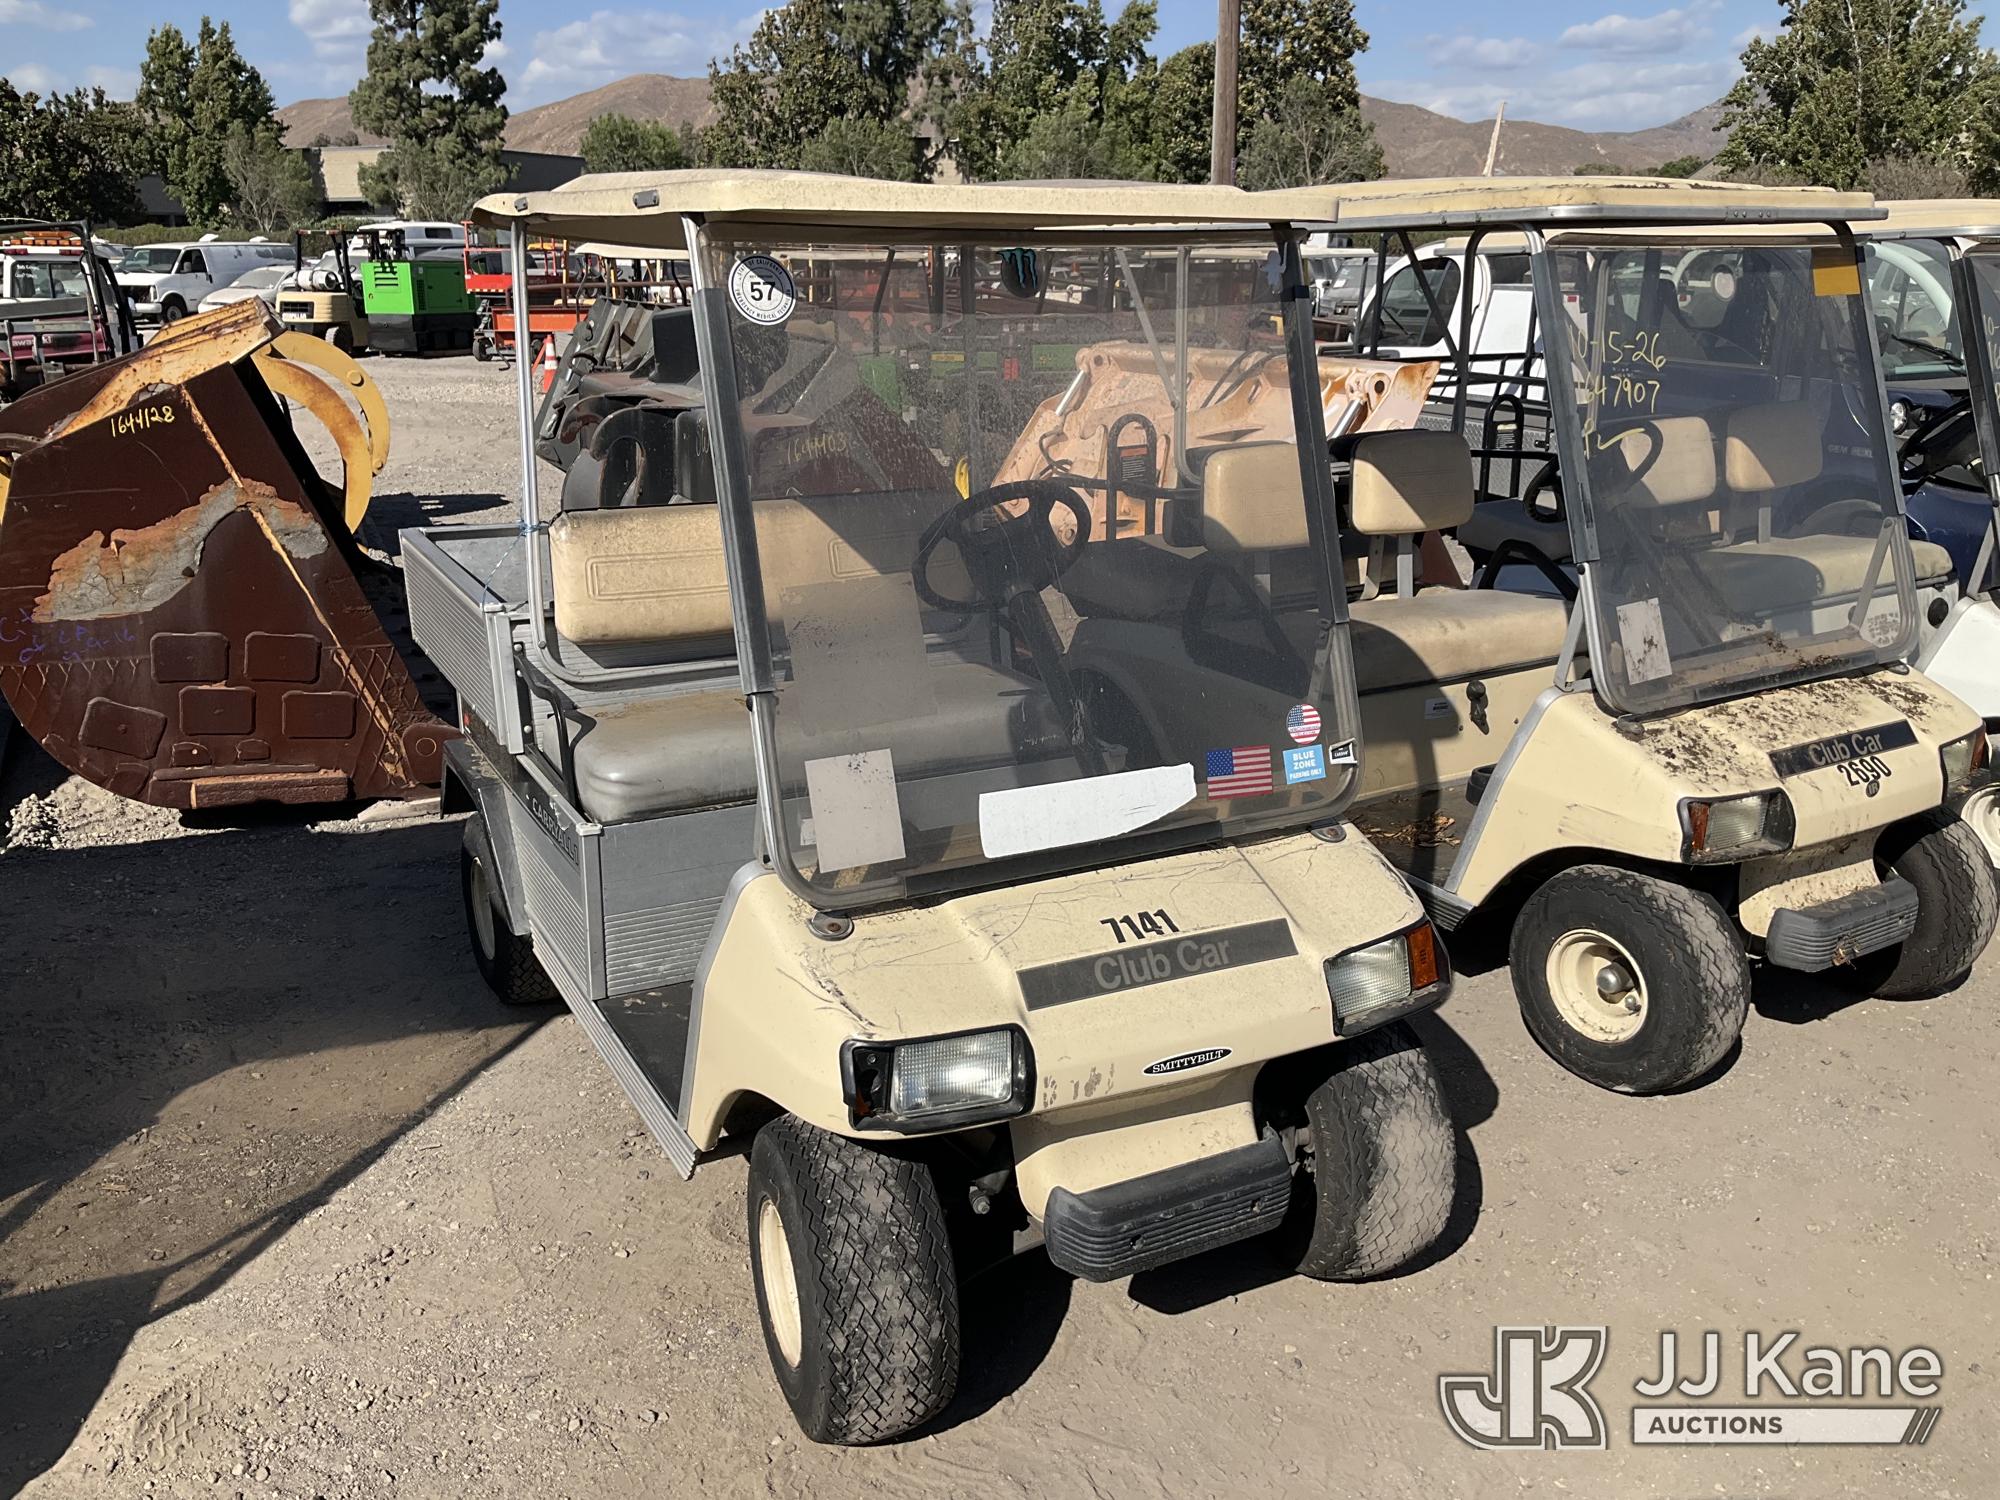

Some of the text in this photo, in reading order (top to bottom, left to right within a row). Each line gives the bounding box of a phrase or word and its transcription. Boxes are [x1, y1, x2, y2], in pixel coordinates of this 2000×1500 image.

[750, 281, 776, 302] 57
[110, 405, 176, 438] 1644128
[1292, 750, 1315, 761] BLUE
[1293, 759, 1317, 770] ZONE
[1808, 732, 1884, 767] Club Car
[1836, 755, 1893, 787] 2690
[1099, 908, 1180, 944] 7141
[1093, 938, 1233, 991] Club Car
[1151, 1048, 1225, 1074] SMITTYBILT
